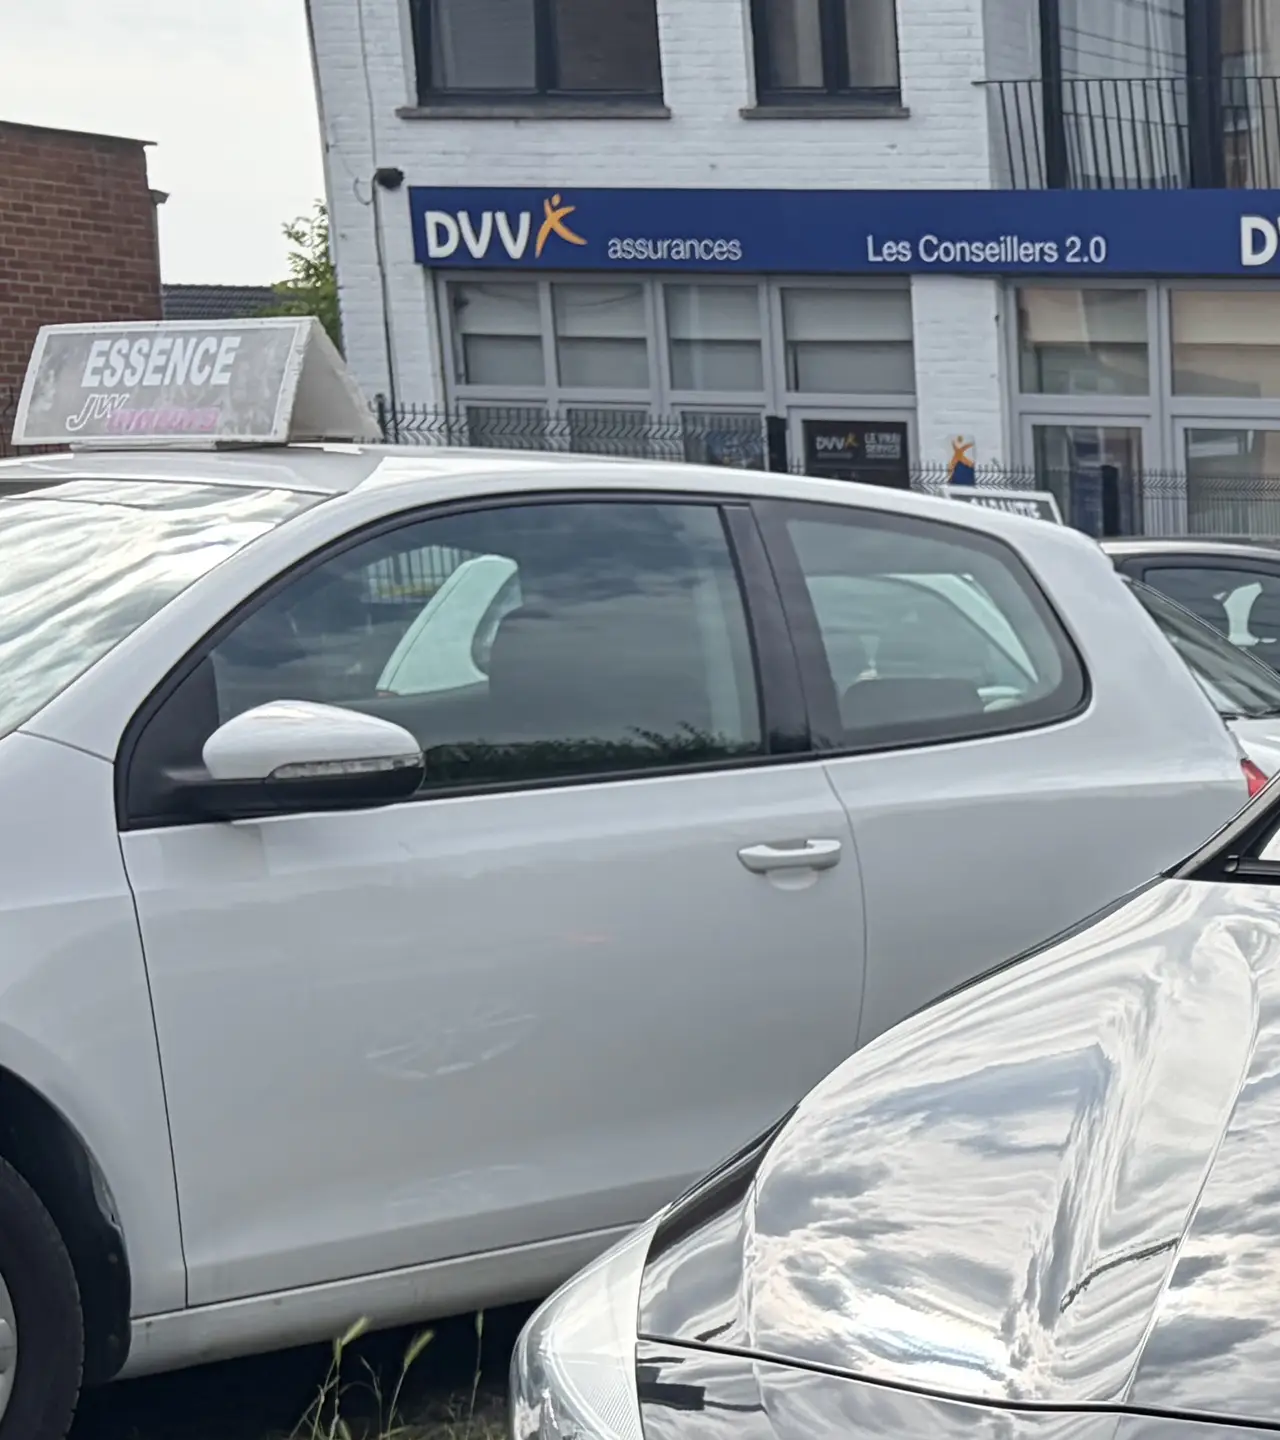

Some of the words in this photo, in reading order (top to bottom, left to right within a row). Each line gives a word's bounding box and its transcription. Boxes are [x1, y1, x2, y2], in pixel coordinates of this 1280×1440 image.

[424, 209, 531, 260] DVV
[607, 234, 742, 262] assurances
[866, 234, 912, 263] Les
[918, 234, 1059, 264] Conseillers
[1065, 235, 1107, 264] 2.0
[81, 335, 242, 388] ESSENCE
